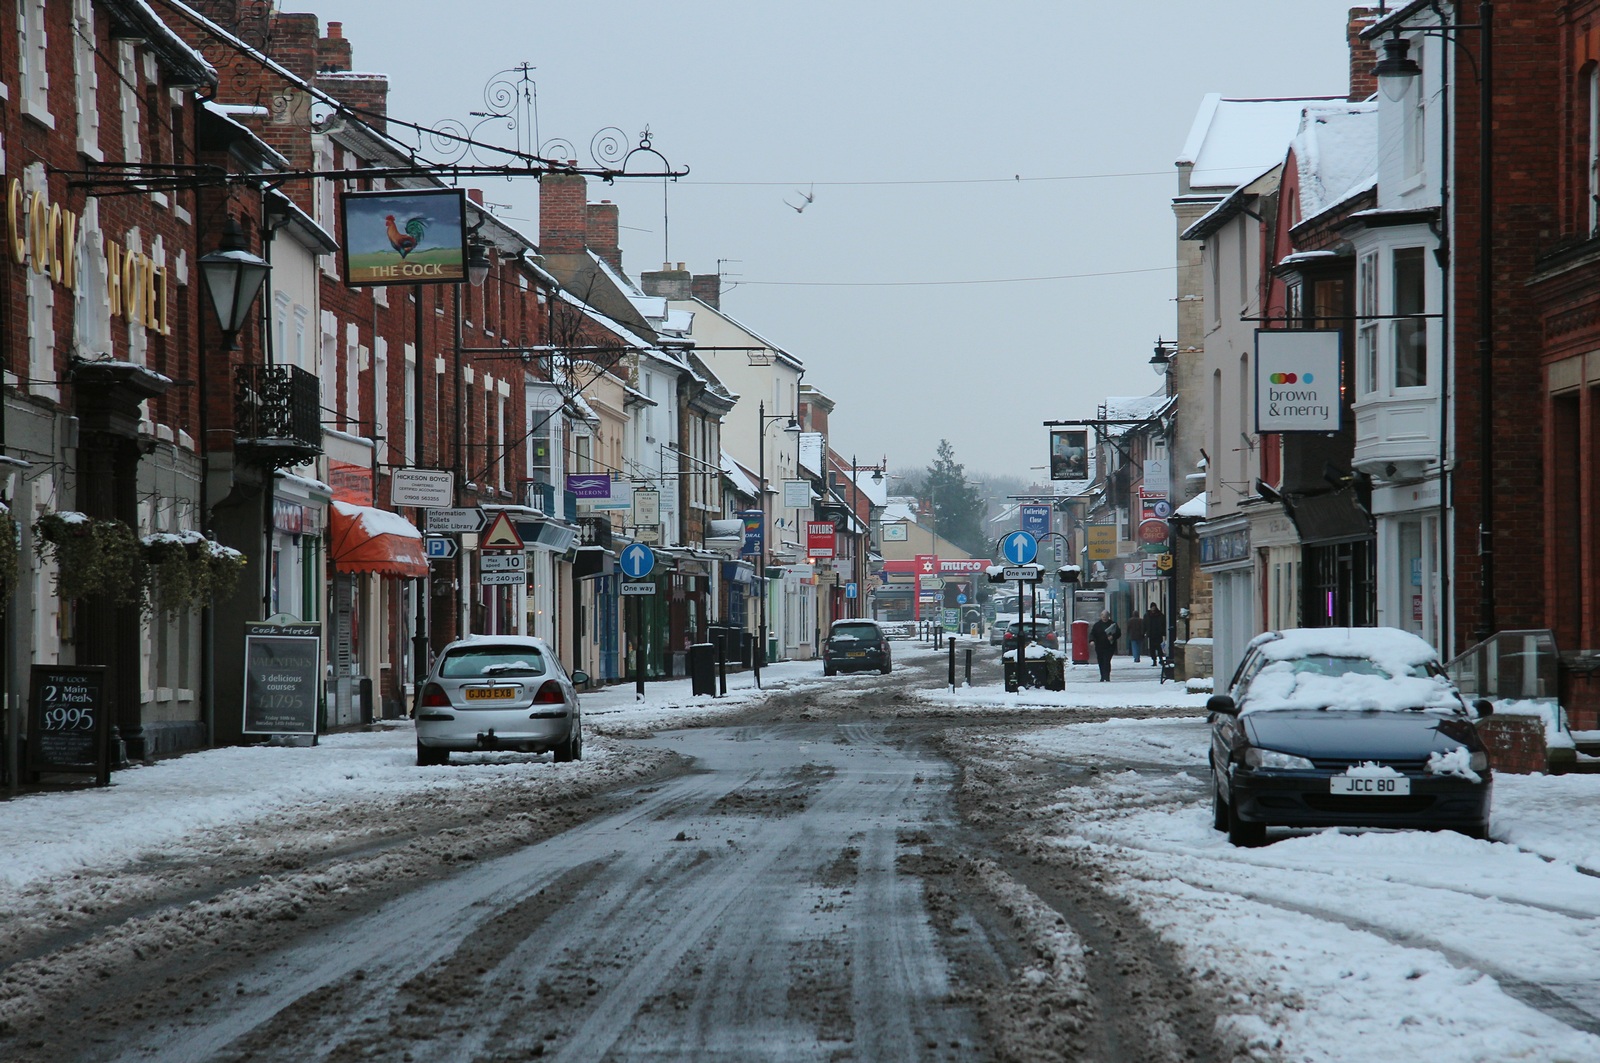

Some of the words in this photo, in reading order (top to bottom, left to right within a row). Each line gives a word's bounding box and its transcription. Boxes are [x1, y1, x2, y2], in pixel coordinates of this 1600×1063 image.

[8, 178, 76, 289] COCK
[107, 240, 170, 336] HOTEL
[370, 265, 399, 277] THE
[403, 263, 443, 276] COCK
[1269, 387, 1317, 401] brown
[1268, 402, 1280, 416] &
[1283, 405, 1329, 420] merry
[808, 524, 834, 534] TAYLORS
[432, 541, 442, 554] P
[505, 557, 520, 567] 10
[940, 562, 982, 570] murco
[251, 626, 279, 634] Cock
[282, 626, 315, 635] Hotel
[261, 674, 266, 682] 3
[268, 674, 302, 682] delicious
[45, 685, 58, 702] 2
[61, 693, 93, 702] Meals
[468, 689, 492, 698] GJ03
[494, 688, 512, 698] EXB
[1346, 779, 1373, 791] JCC
[1377, 779, 1395, 792] 80
